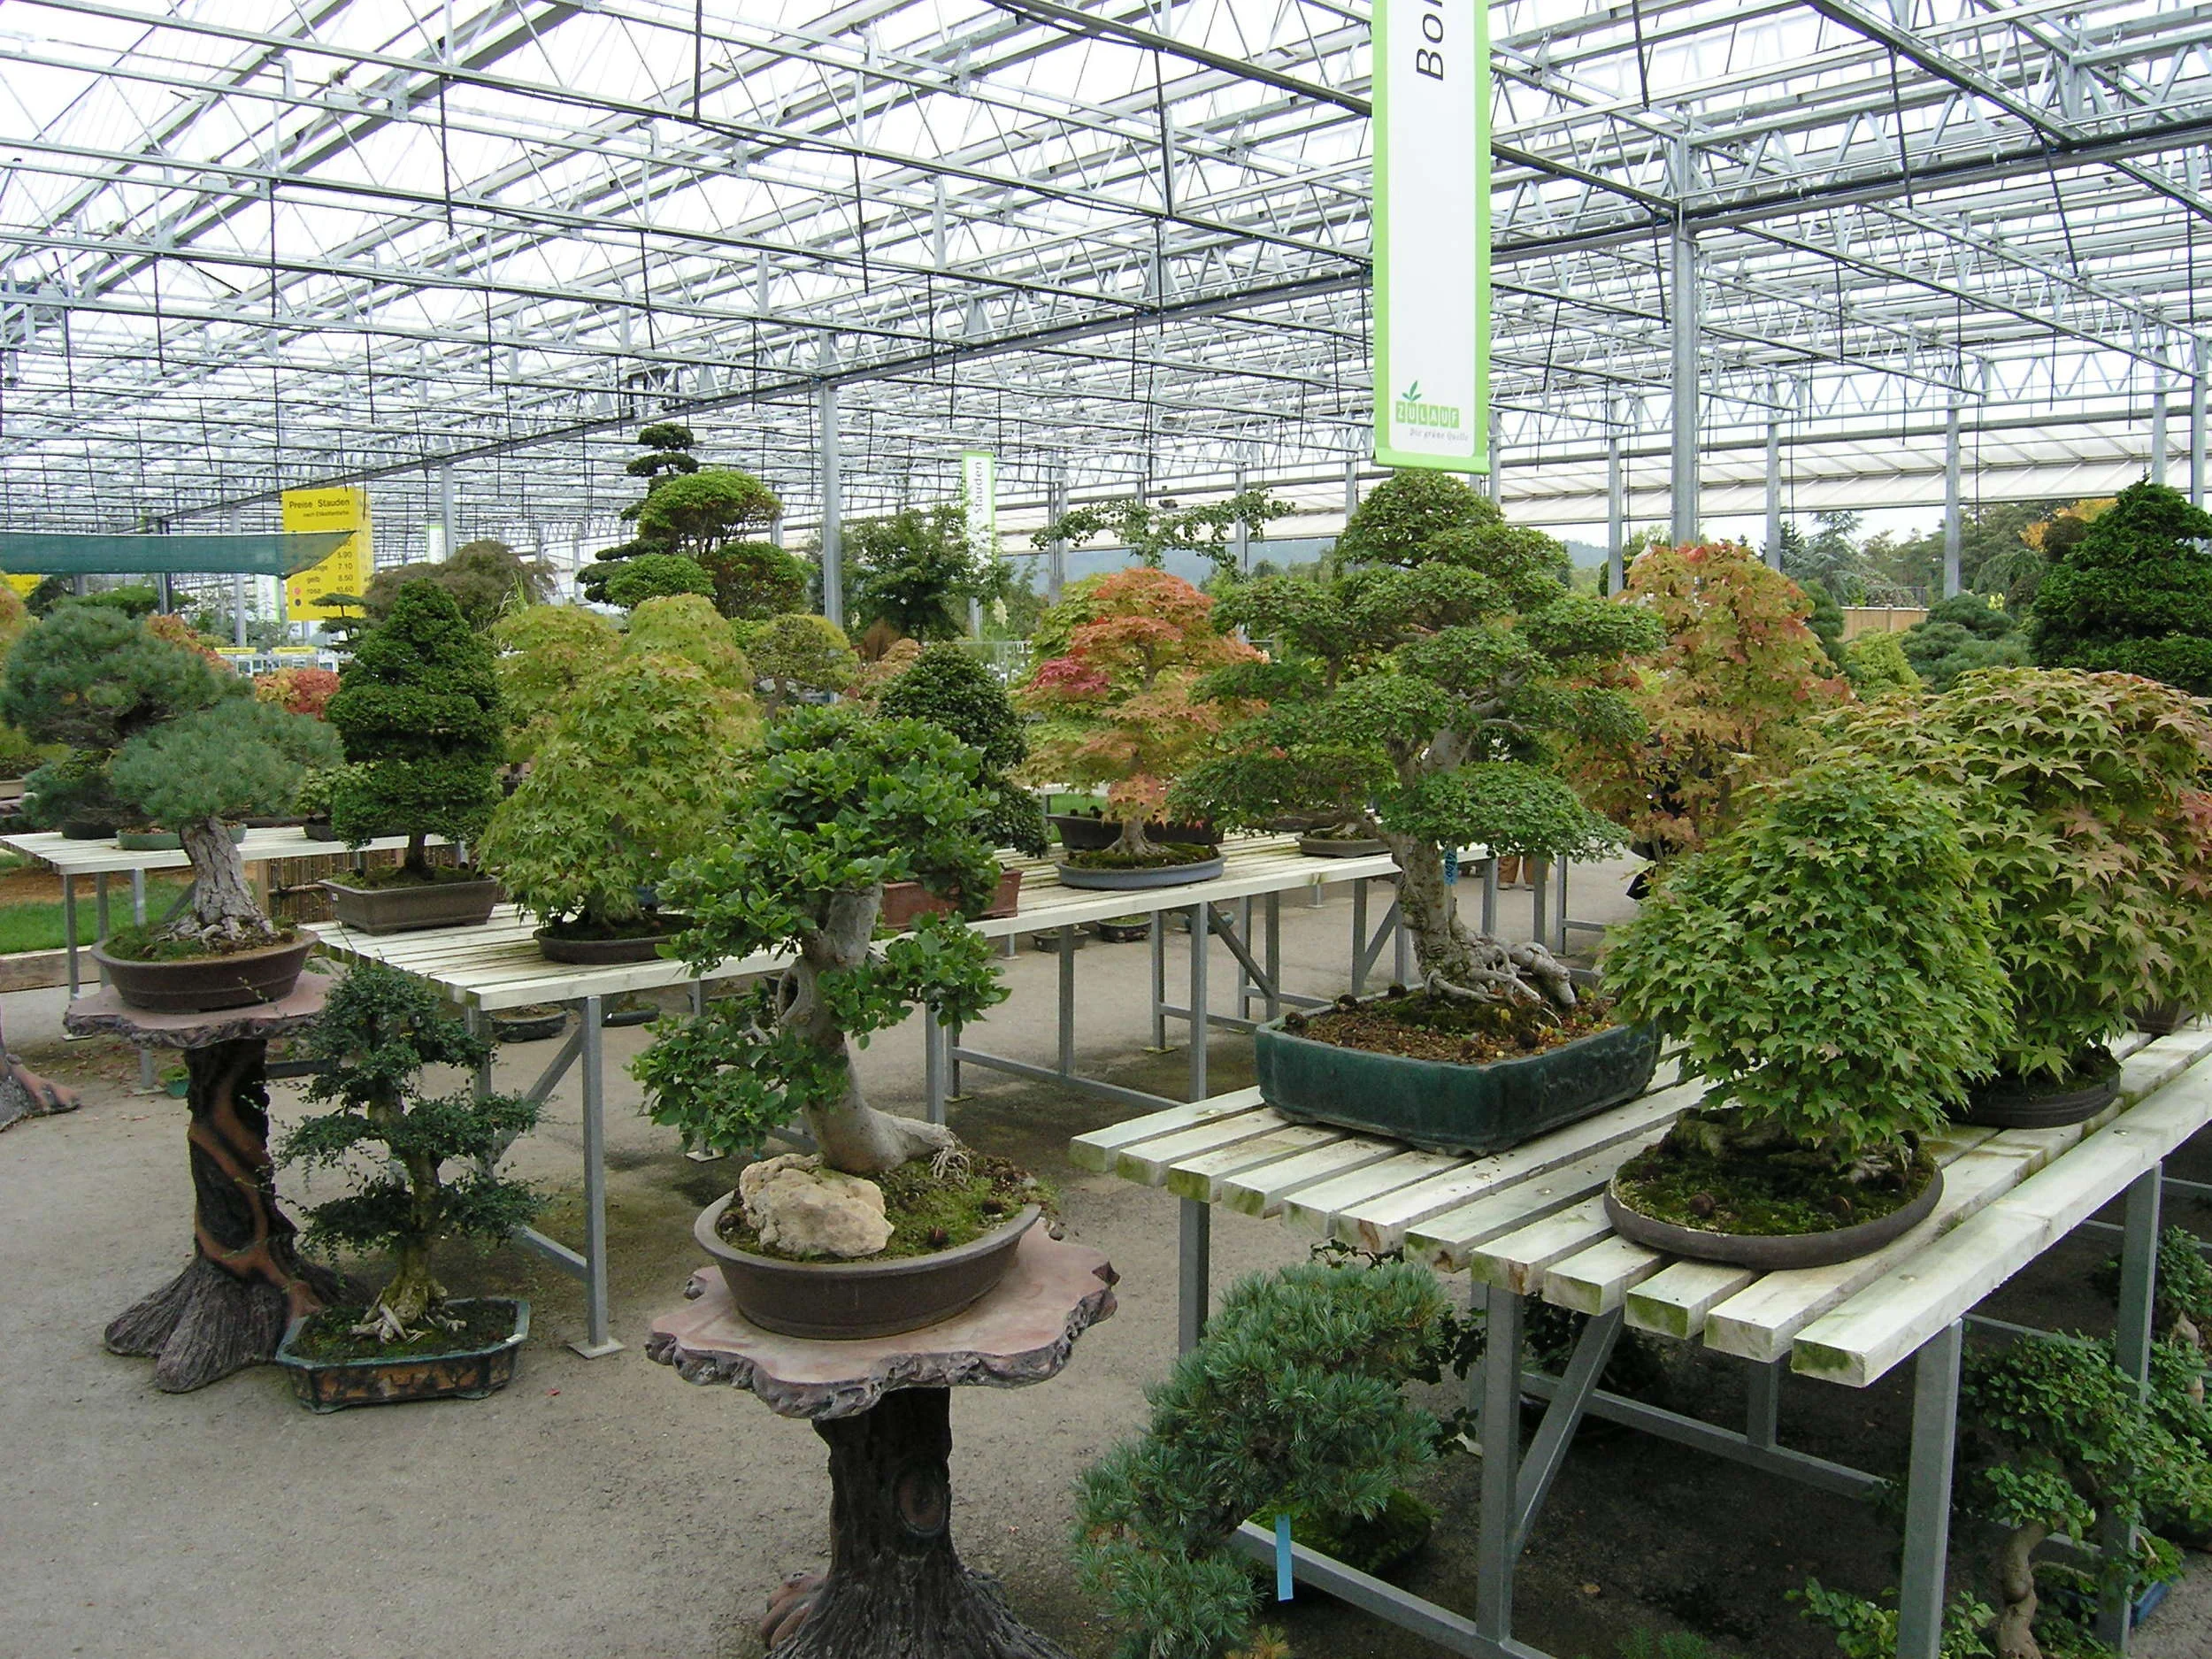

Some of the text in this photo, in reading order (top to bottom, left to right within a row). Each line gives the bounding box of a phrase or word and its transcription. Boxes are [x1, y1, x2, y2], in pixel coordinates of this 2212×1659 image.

[1397, 403, 1459, 426] ZULAUF
[973, 462, 983, 514] Stauden
[318, 498, 349, 508] Stauden
